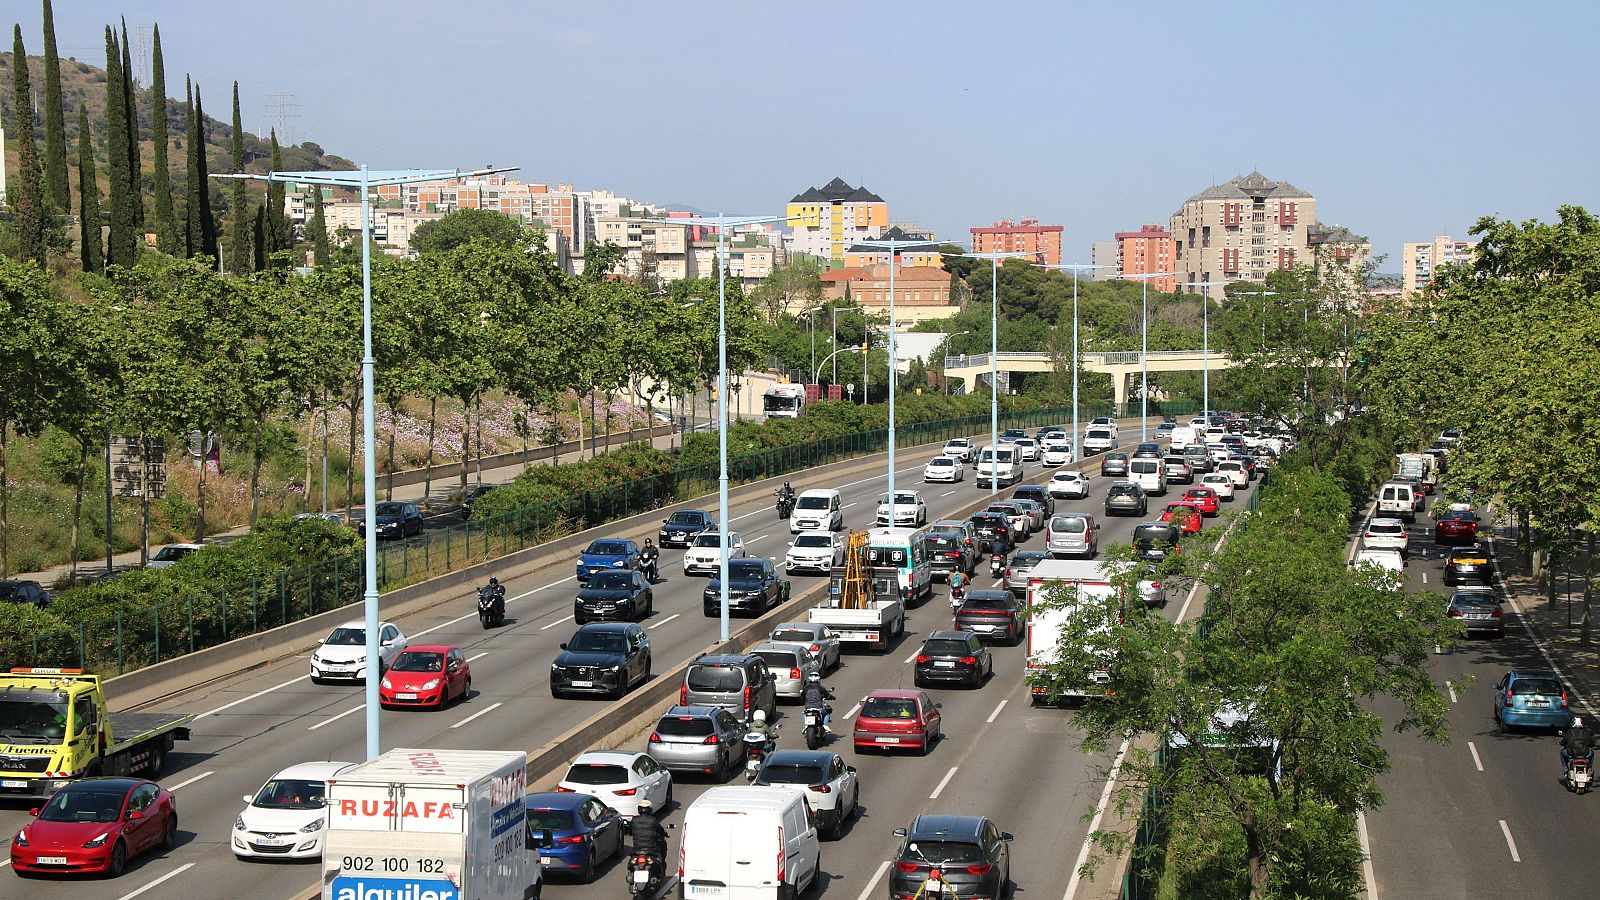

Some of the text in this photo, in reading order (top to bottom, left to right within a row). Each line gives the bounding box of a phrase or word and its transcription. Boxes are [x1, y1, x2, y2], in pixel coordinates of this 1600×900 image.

[341, 799, 454, 819] RUZAFA
[343, 856, 444, 873] 902 100 182
